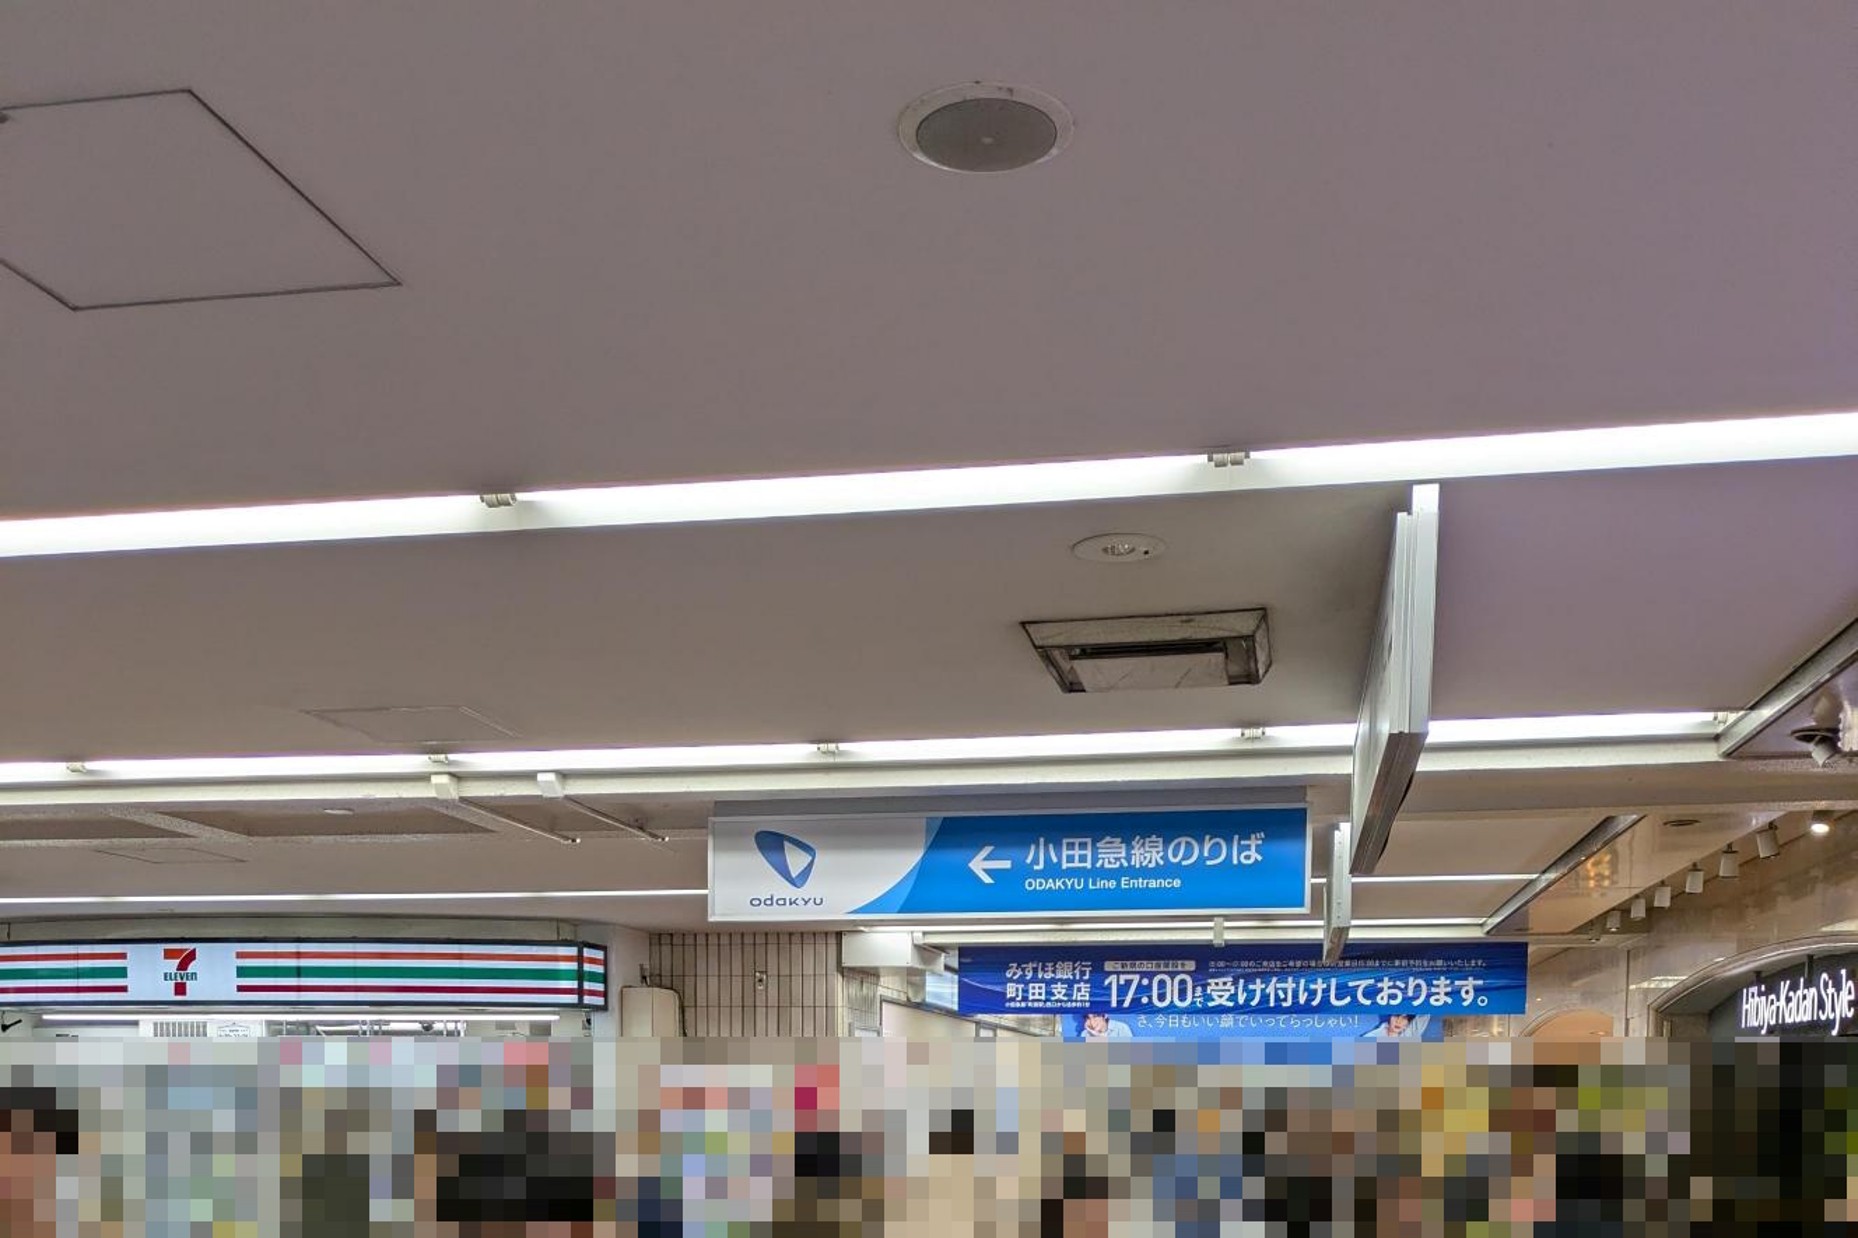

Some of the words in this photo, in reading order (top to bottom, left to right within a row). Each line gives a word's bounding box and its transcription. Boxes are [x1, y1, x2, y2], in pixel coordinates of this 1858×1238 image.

[1025, 832, 1265, 870] 小田急線のりば
[1025, 878, 1084, 891] ODAKYU
[1088, 877, 1117, 890] Line
[1121, 876, 1181, 889] Entrance
[1005, 961, 1092, 979] みずほ銀行
[1005, 983, 1090, 1001] 町田支店
[1818, 968, 1855, 1036] Style
